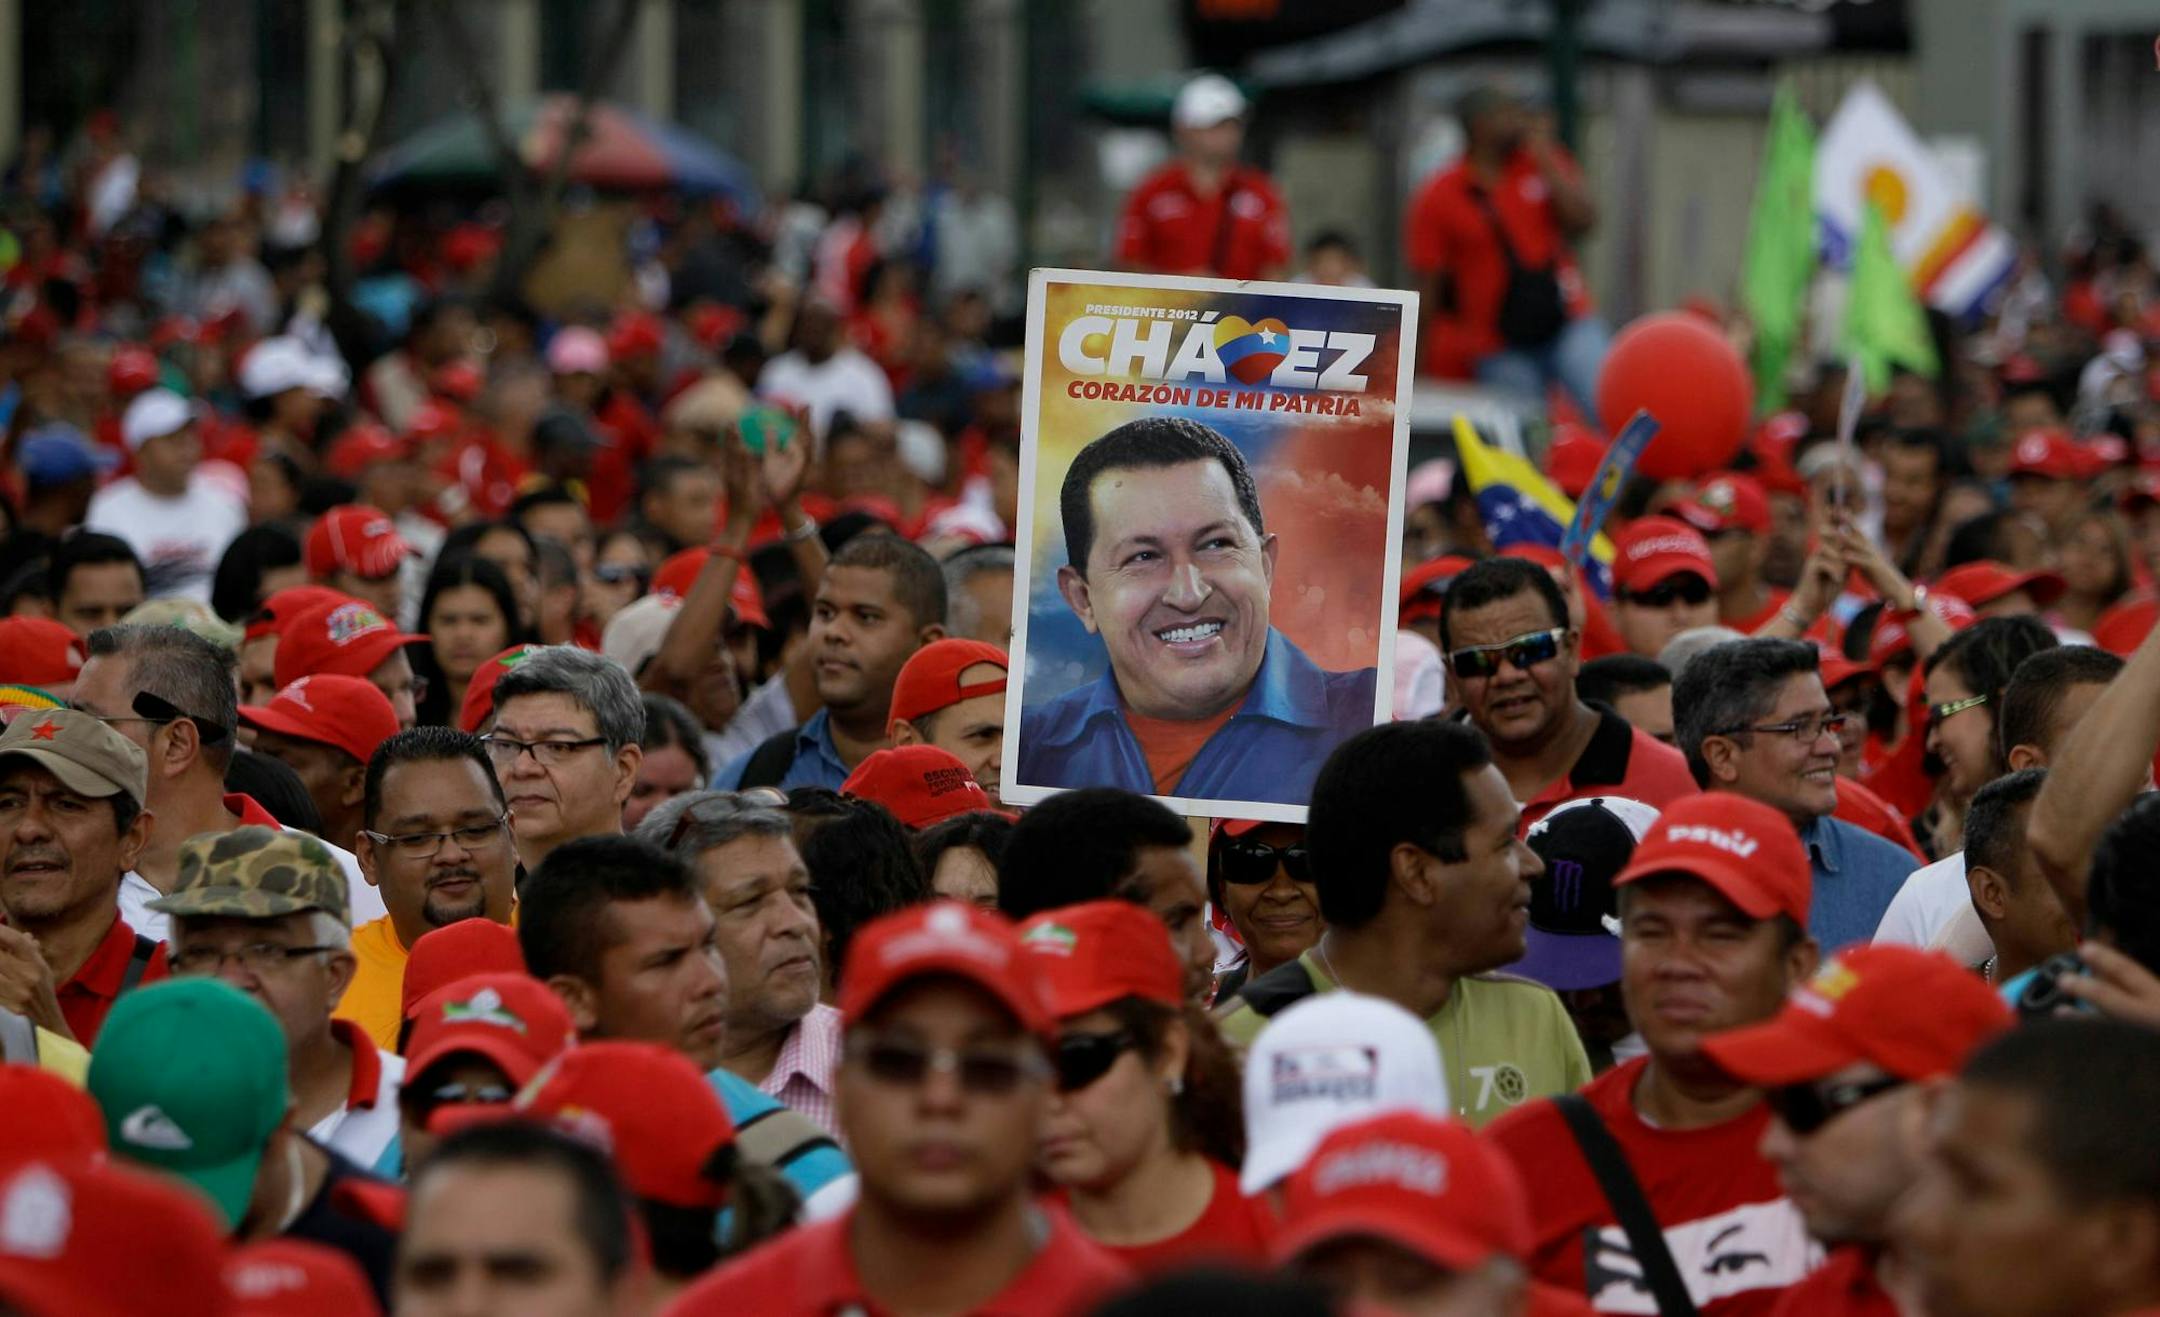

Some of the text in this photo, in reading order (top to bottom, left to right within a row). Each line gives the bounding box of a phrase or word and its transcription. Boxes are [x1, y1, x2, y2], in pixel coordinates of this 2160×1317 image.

[1085, 304, 1198, 320] PRESIDENTE 2012
[1067, 380, 1361, 417] CORAZÓN DE MI PATRIA
